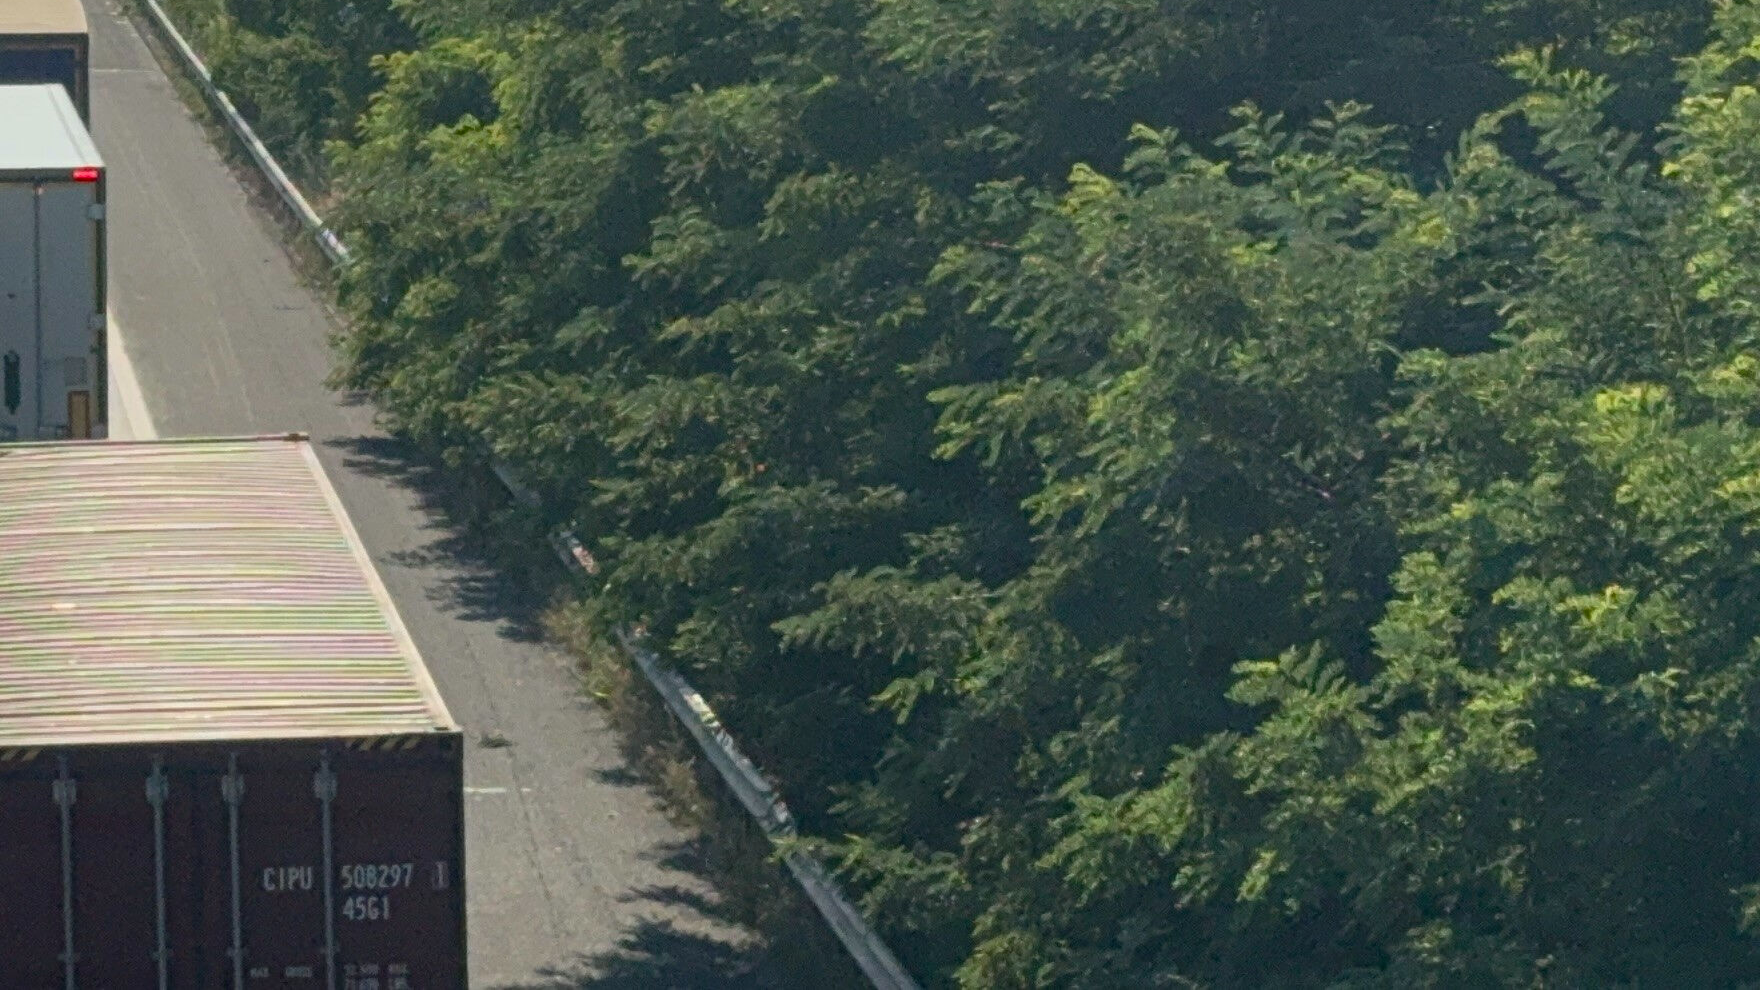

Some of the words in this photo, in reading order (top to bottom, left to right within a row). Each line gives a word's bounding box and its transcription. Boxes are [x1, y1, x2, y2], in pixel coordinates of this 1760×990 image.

[263, 865, 313, 891] CIPU
[341, 862, 413, 889] 508297
[342, 896, 389, 921] 45G1
